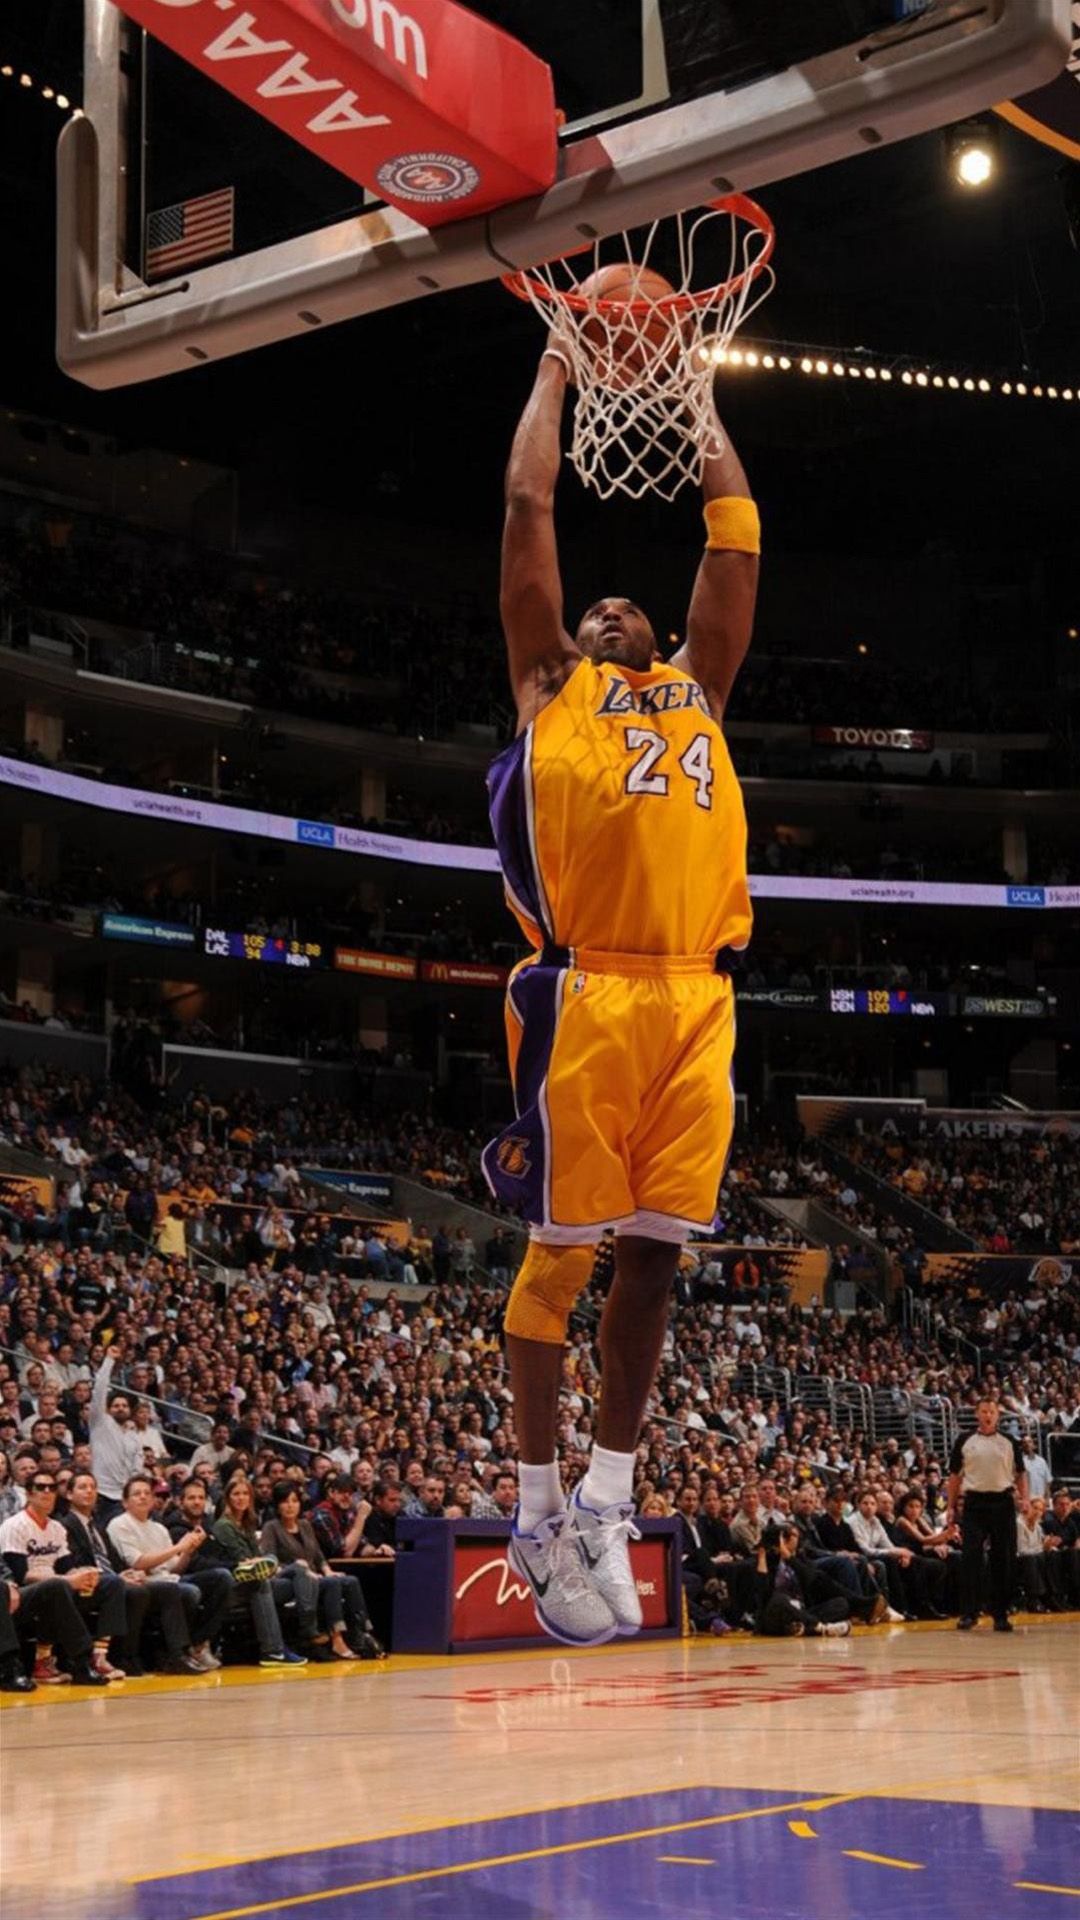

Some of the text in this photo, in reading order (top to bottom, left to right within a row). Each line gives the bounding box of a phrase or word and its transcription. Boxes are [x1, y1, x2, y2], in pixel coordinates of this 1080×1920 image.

[156, 0, 392, 134] AAA.
[832, 727, 913, 749] TOYOTA
[624, 727, 714, 811] 24
[300, 826, 332, 842] UCLA
[1011, 891, 1080, 904] UCLA Healt
[205, 941, 230, 957] LAC
[286, 953, 310, 967] NBA
[830, 1001, 855, 1013] DEN
[911, 1002, 935, 1015] NBA
[984, 999, 1023, 1014] WEST
[919, 1119, 1023, 1139] LAKERS
